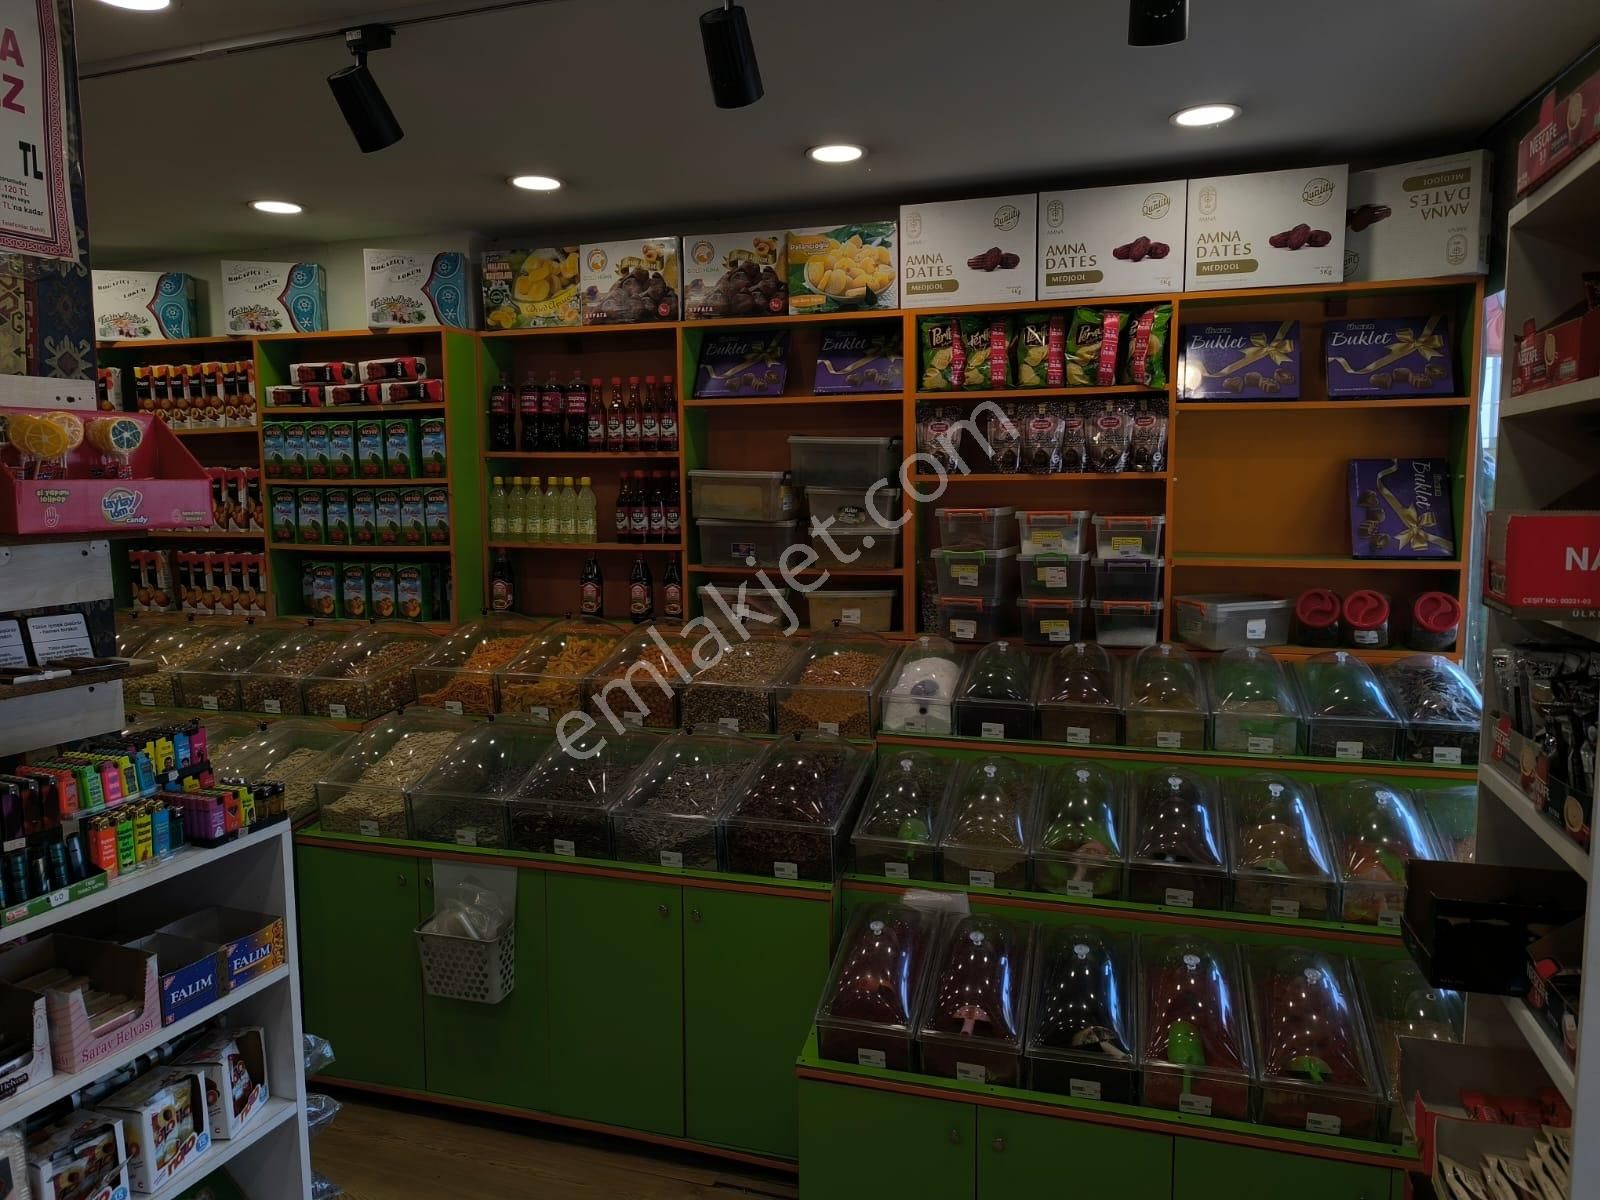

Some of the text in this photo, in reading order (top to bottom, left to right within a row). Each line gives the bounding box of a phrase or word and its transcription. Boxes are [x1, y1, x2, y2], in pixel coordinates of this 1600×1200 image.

[19, 140, 43, 180] TL
[1409, 186, 1471, 208] DATES
[1421, 201, 1469, 221] AMNA
[1197, 229, 1241, 246] AMNA
[1046, 242, 1087, 259] AMNA
[1196, 242, 1252, 259] DATES
[906, 252, 944, 266] AMNA
[1045, 254, 1097, 270] DATES
[906, 265, 953, 280] DATES
[1201, 263, 1240, 273] MEDJOOL
[1051, 273, 1086, 284] MEDJOOL
[911, 282, 944, 292] MEDJOOL
[823, 335, 867, 351] Buklet
[1191, 334, 1248, 350] Buklet
[1331, 331, 1393, 346] Buklet
[705, 343, 748, 356] Buklet
[1412, 460, 1432, 510] Buklet
[126, 515, 148, 525] candy
[233, 943, 271, 971] FALIM
[170, 973, 213, 1004] FALIM
